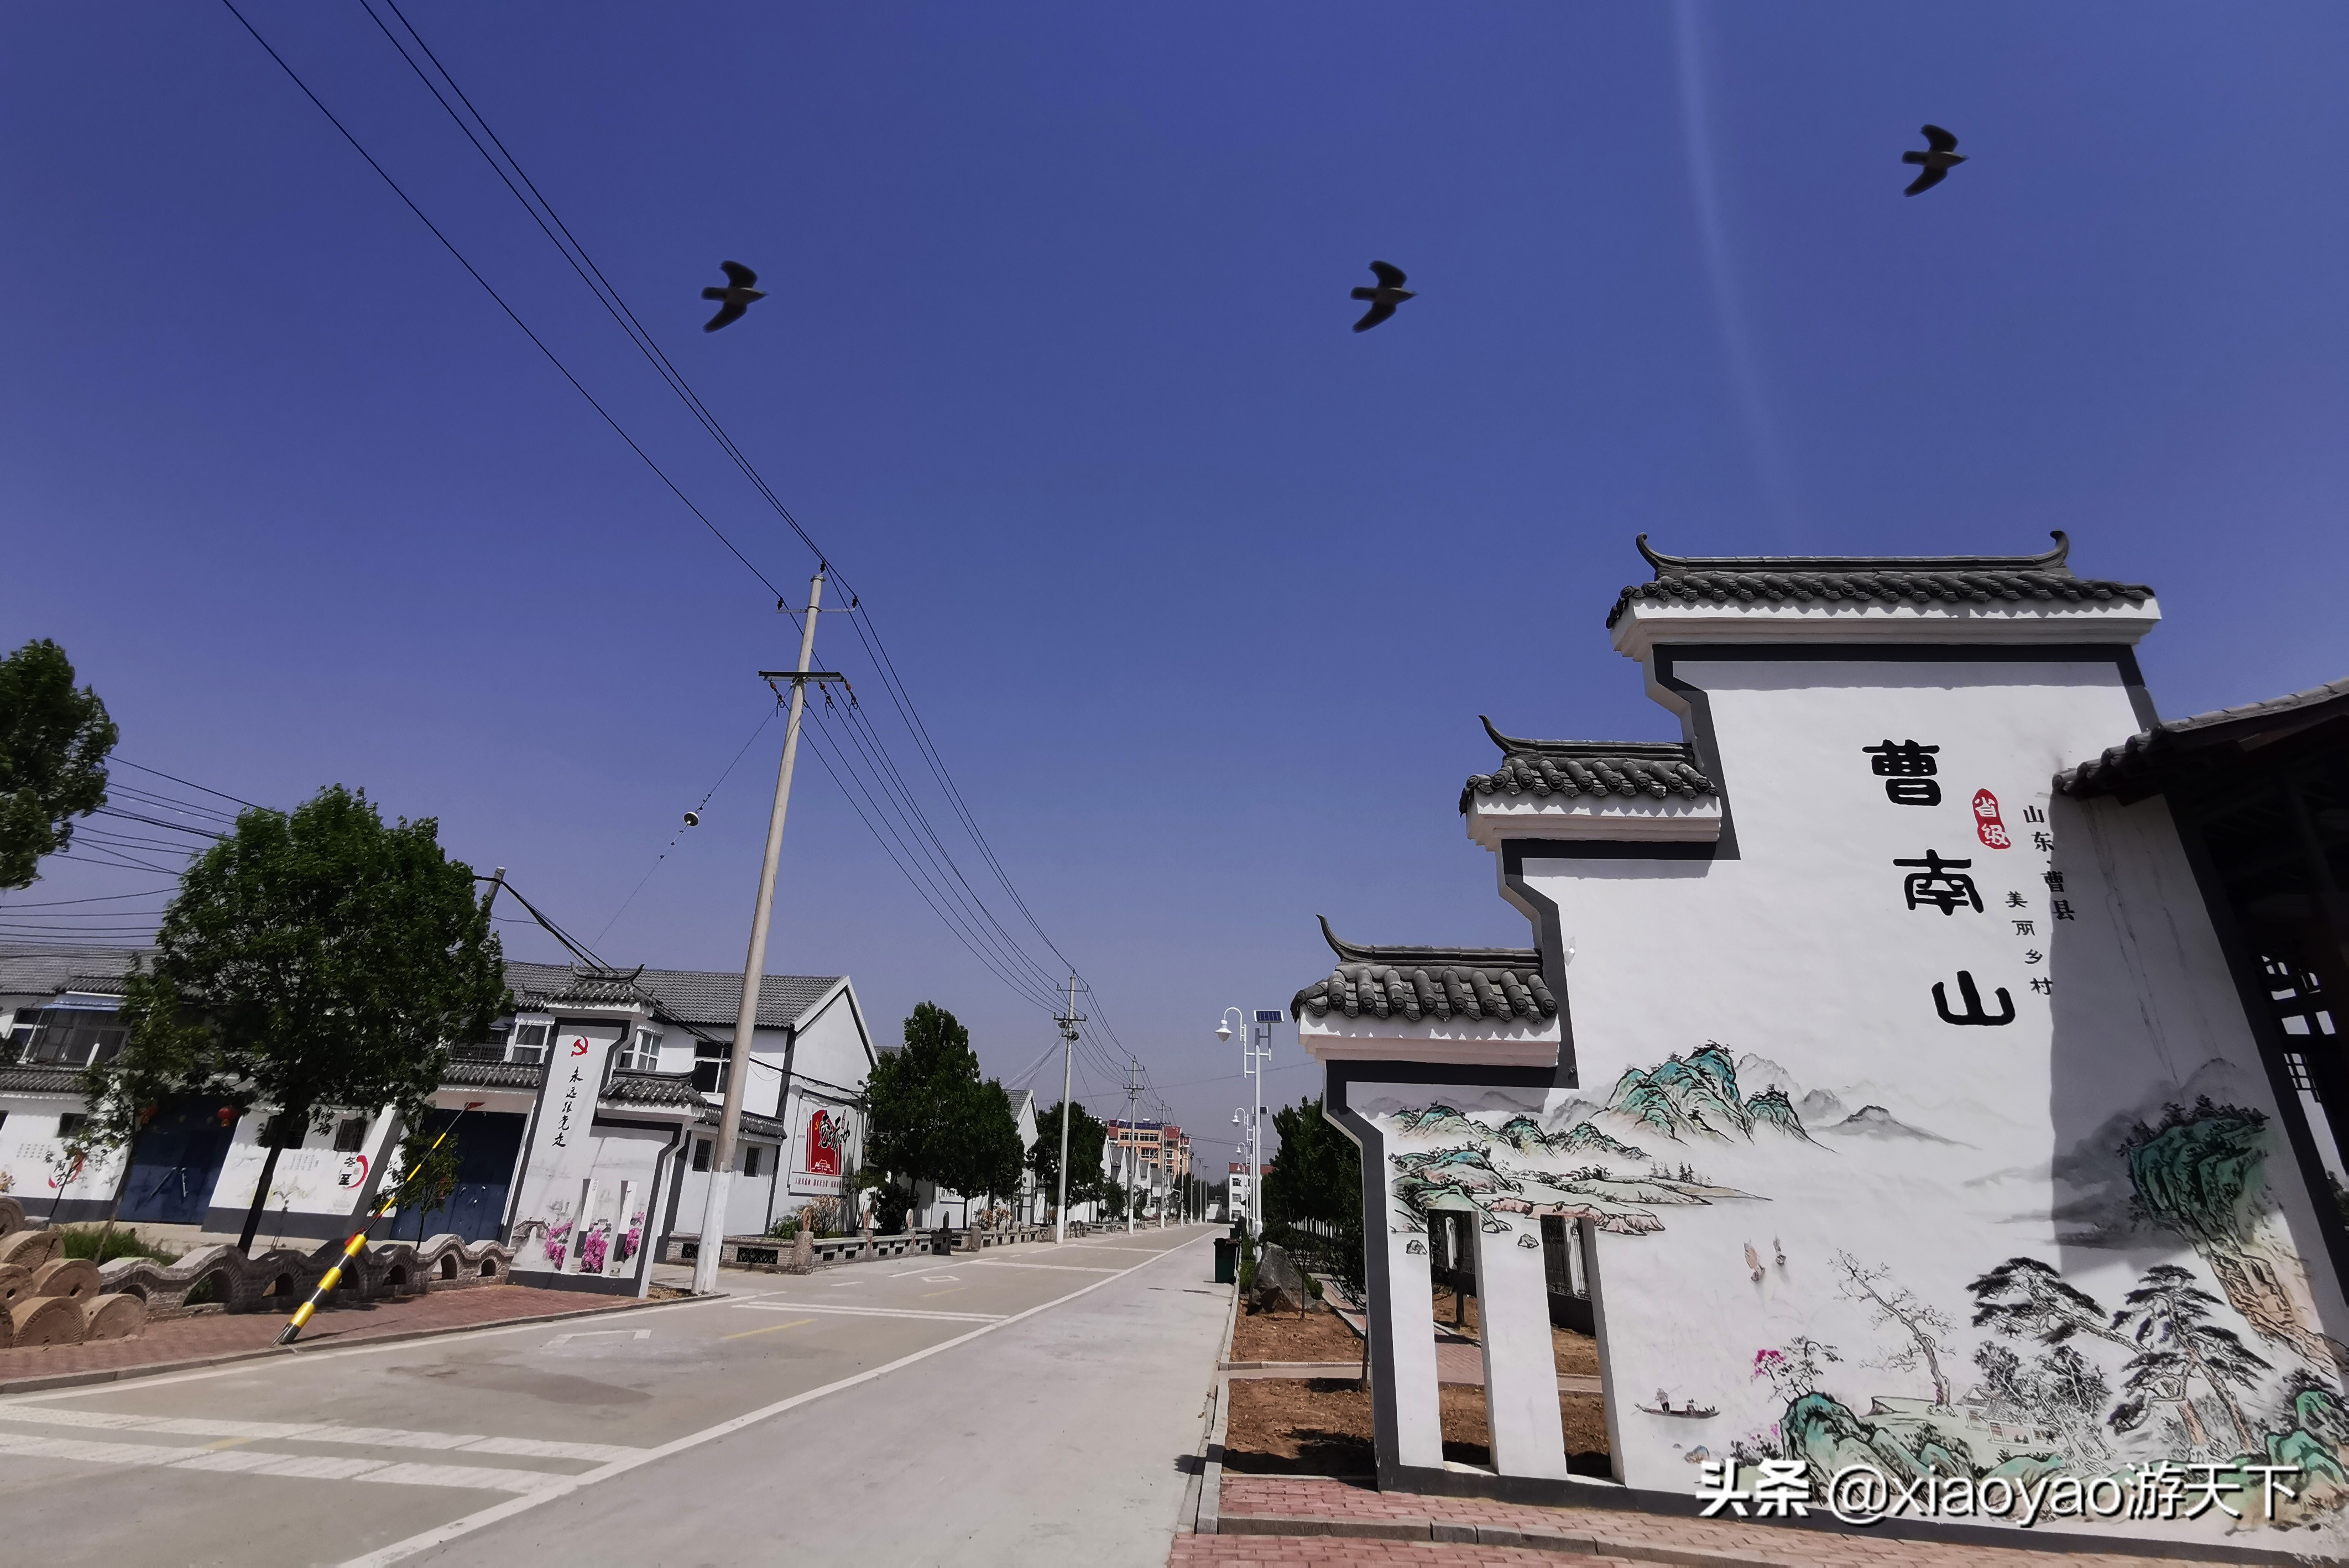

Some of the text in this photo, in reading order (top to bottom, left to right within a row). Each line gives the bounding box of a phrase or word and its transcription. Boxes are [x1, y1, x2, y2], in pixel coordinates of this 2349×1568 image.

[1975, 796, 2009, 846] 省级
[2022, 805, 2076, 922] 山东·曹县
[1862, 739, 2016, 1027] 曹南山
[2005, 891, 2054, 996] 美丽乡村
[552, 1066, 583, 1148] 永远跟党走
[338, 1156, 356, 1185] 冬至
